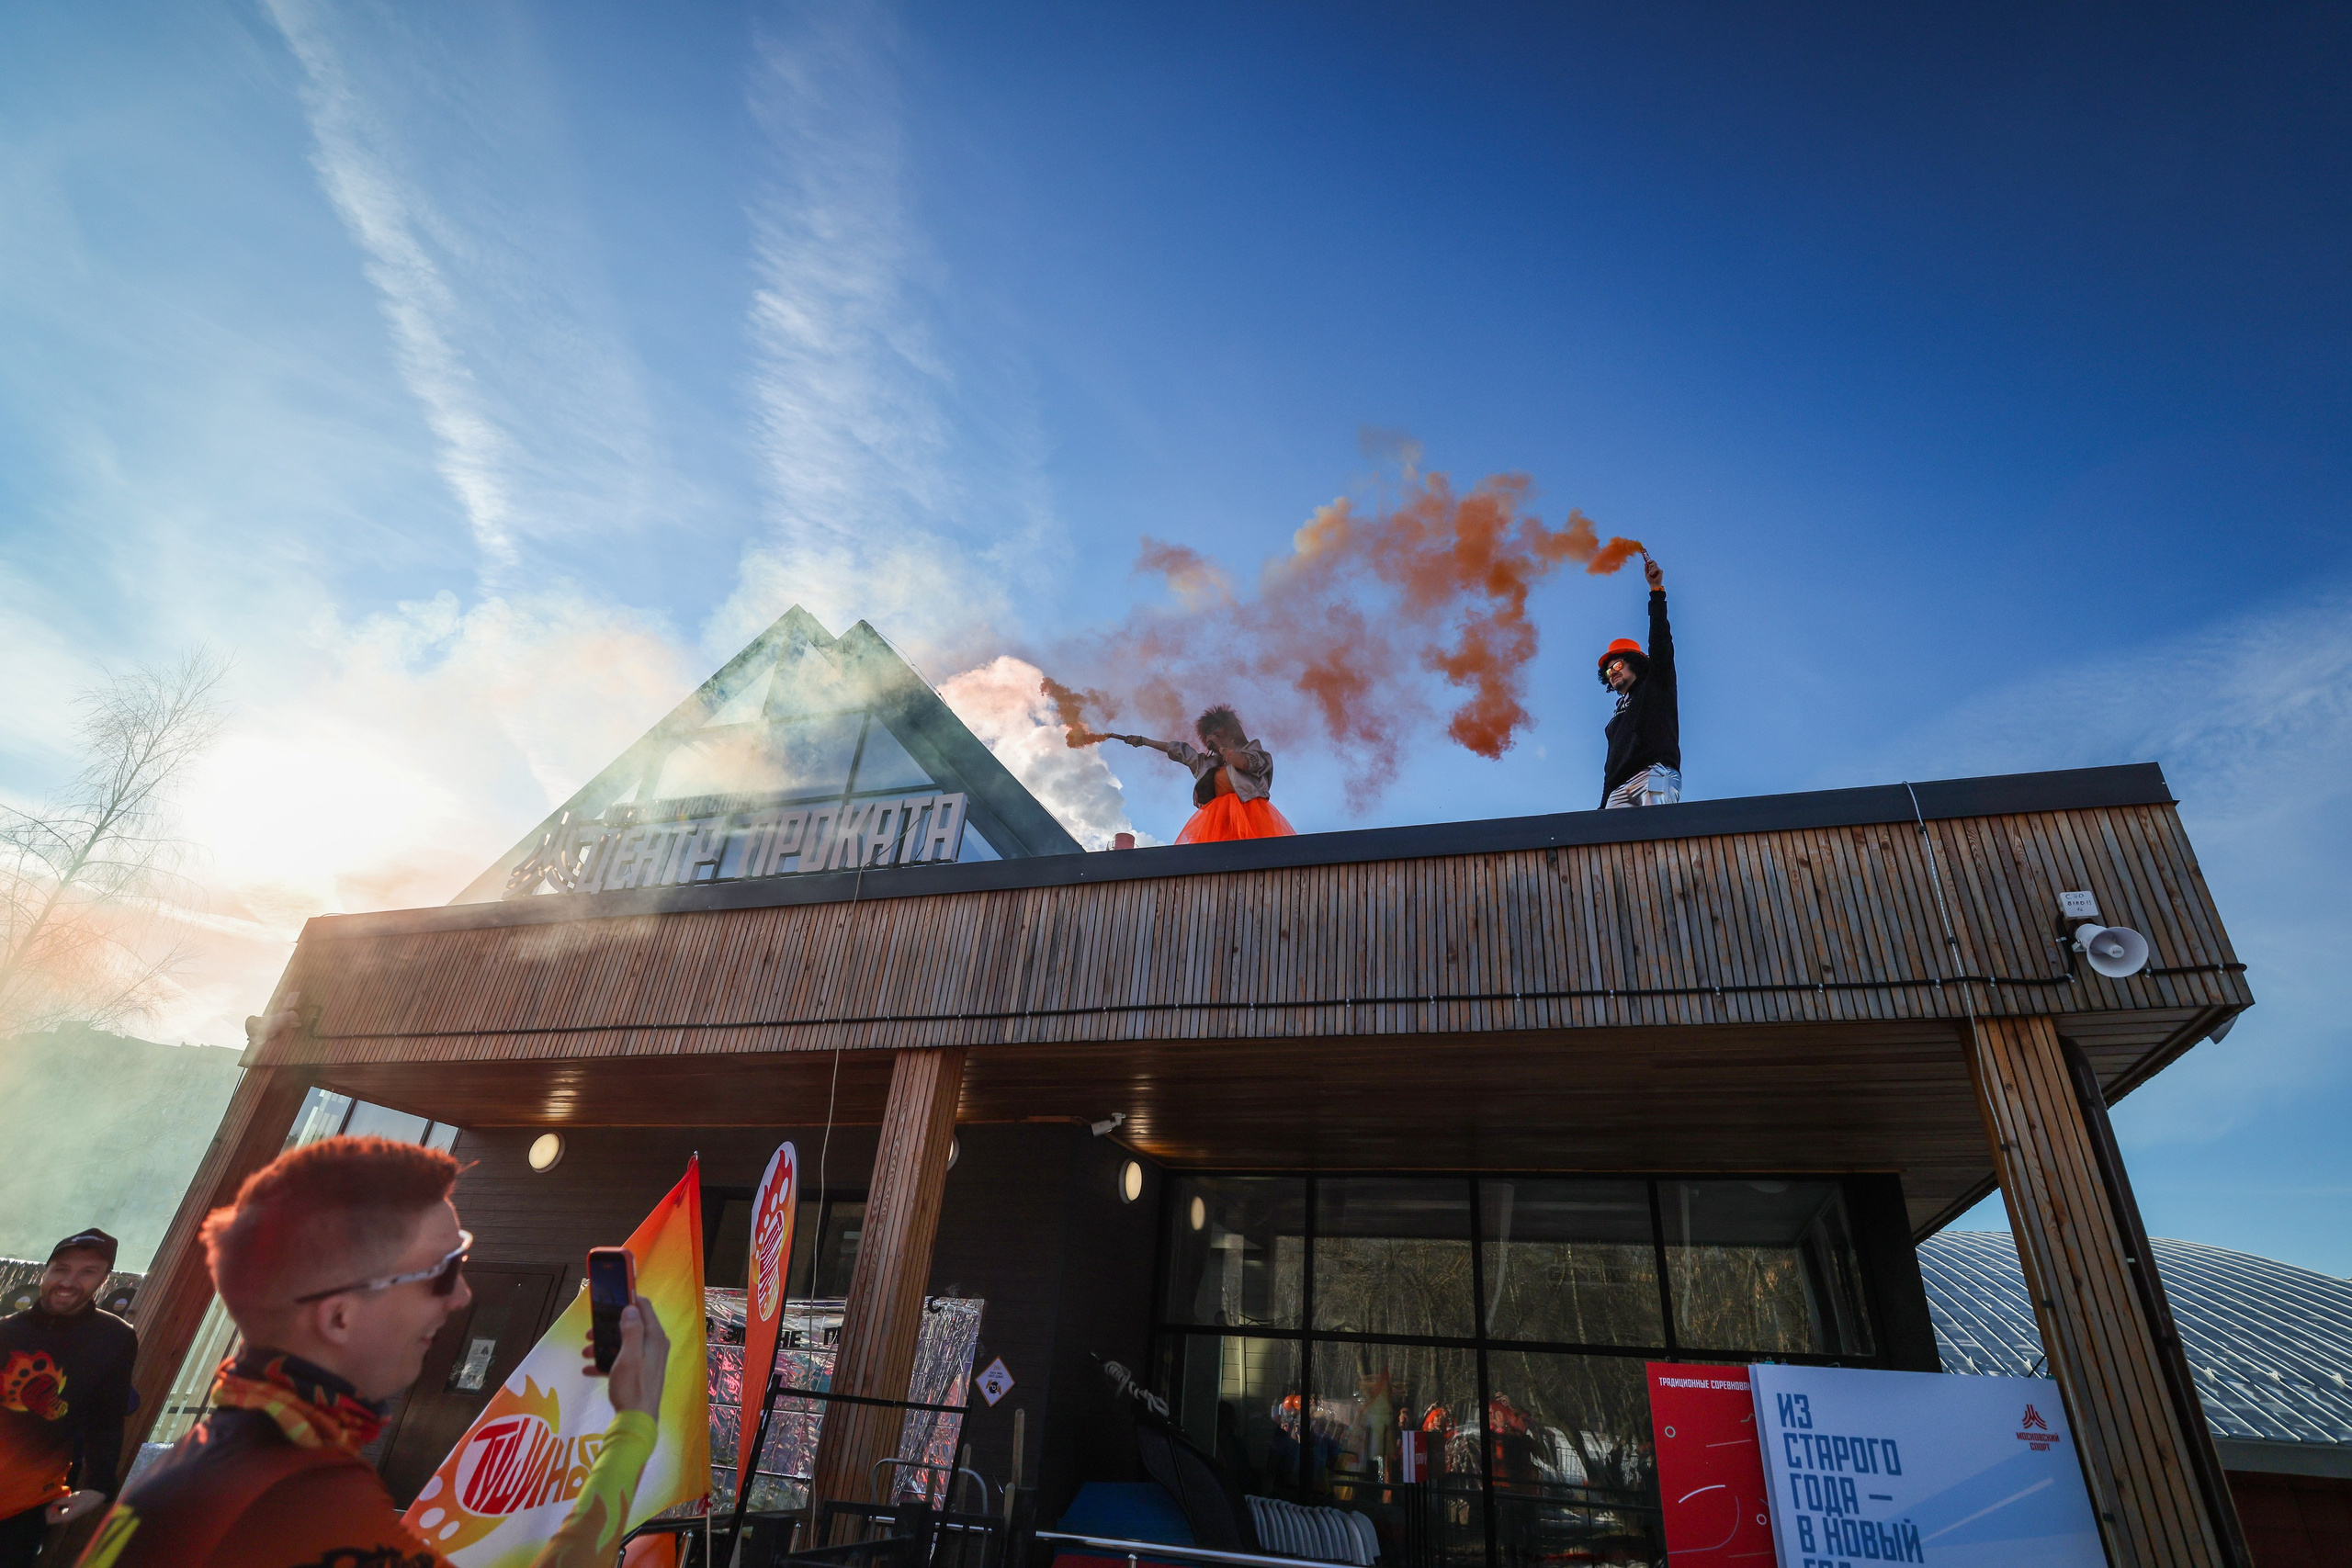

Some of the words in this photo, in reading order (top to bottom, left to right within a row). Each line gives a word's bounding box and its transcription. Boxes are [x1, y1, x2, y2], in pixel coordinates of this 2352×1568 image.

[573, 815, 728, 895] ЦЕНТР
[733, 792, 967, 878] ПРОКАТА
[1658, 1377, 1710, 1389] ТРАДИЦИОННЫЕ
[1777, 1393, 1813, 1428] ИЗ
[1783, 1432, 1902, 1475] СТАРОГО
[2016, 1432, 2060, 1442] МОСКОВСКИЙ
[2030, 1442, 2051, 1451] СПОРТ
[1790, 1472, 1860, 1517] ГОДА
[1796, 1515, 1816, 1553] В
[1823, 1518, 1924, 1563] НОВЫЙ
